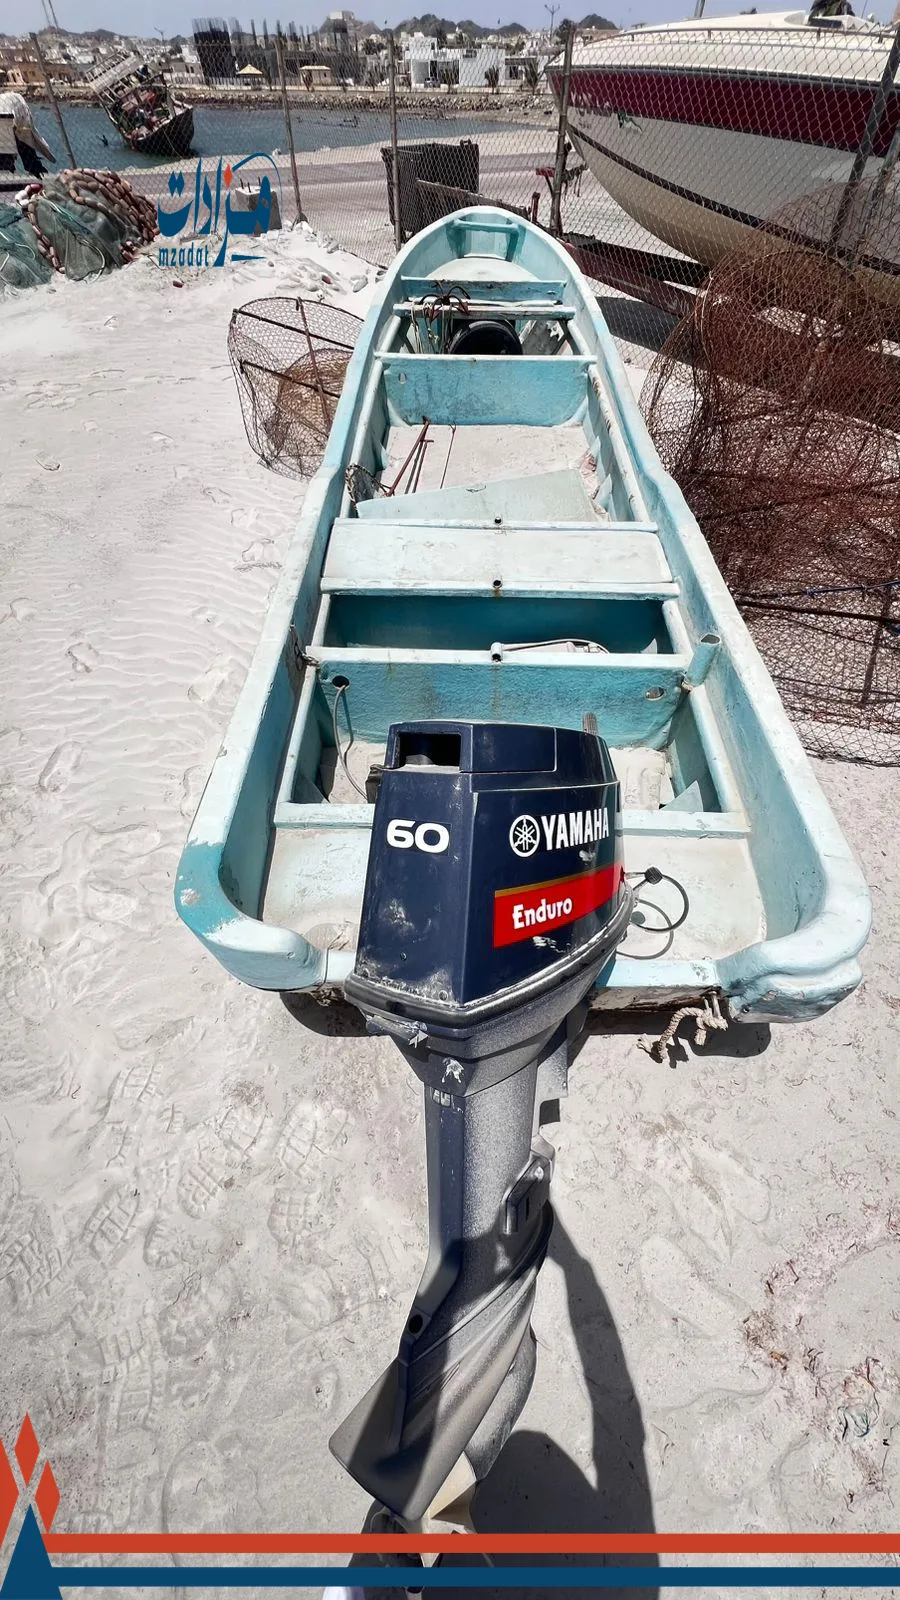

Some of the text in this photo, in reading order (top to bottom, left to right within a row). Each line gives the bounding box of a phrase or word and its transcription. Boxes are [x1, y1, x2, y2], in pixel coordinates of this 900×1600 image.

[386, 819, 450, 853] 60
[541, 807, 609, 850] YAMAHA
[512, 898, 573, 929] Enduro
